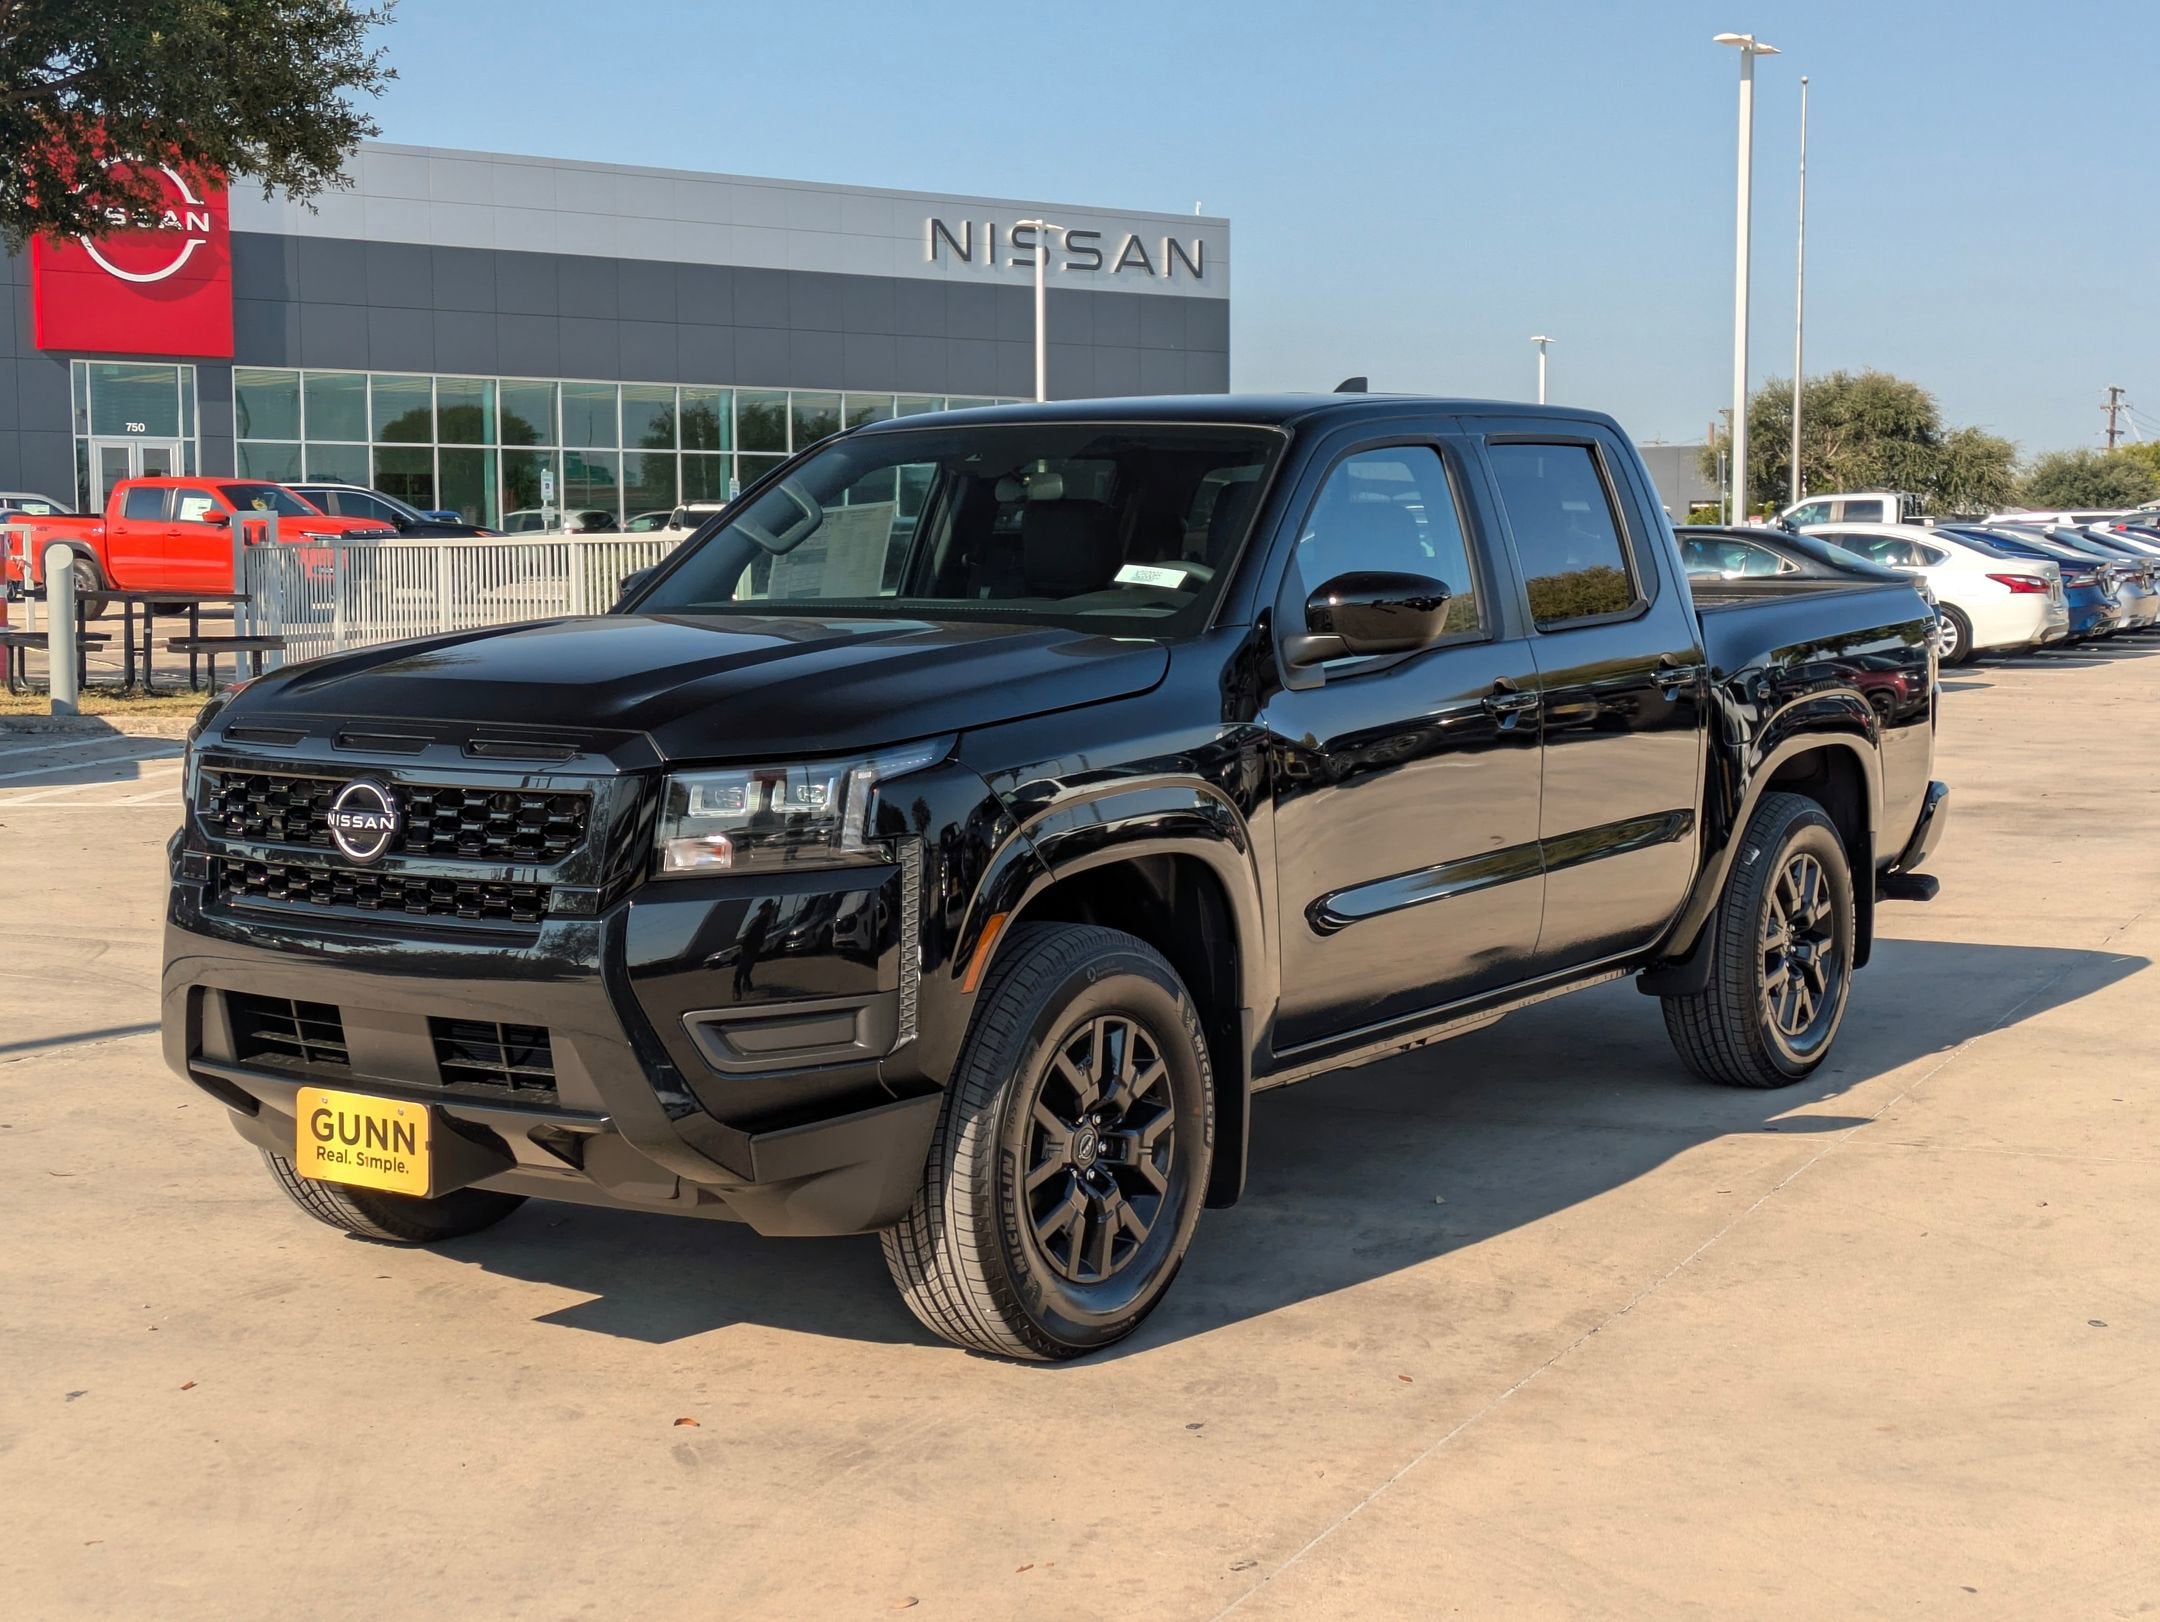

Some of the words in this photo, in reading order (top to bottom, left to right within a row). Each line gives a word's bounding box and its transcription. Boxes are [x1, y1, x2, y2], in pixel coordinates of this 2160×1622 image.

[927, 217, 1203, 279] NISSAN
[125, 422, 146, 433] 750
[327, 813, 395, 830] NISSAN
[1194, 1034, 1214, 1144] MICHELIN
[311, 1108, 415, 1156] GUNN
[316, 1146, 352, 1165] Real.
[1002, 1154, 1028, 1275] MICHELIN
